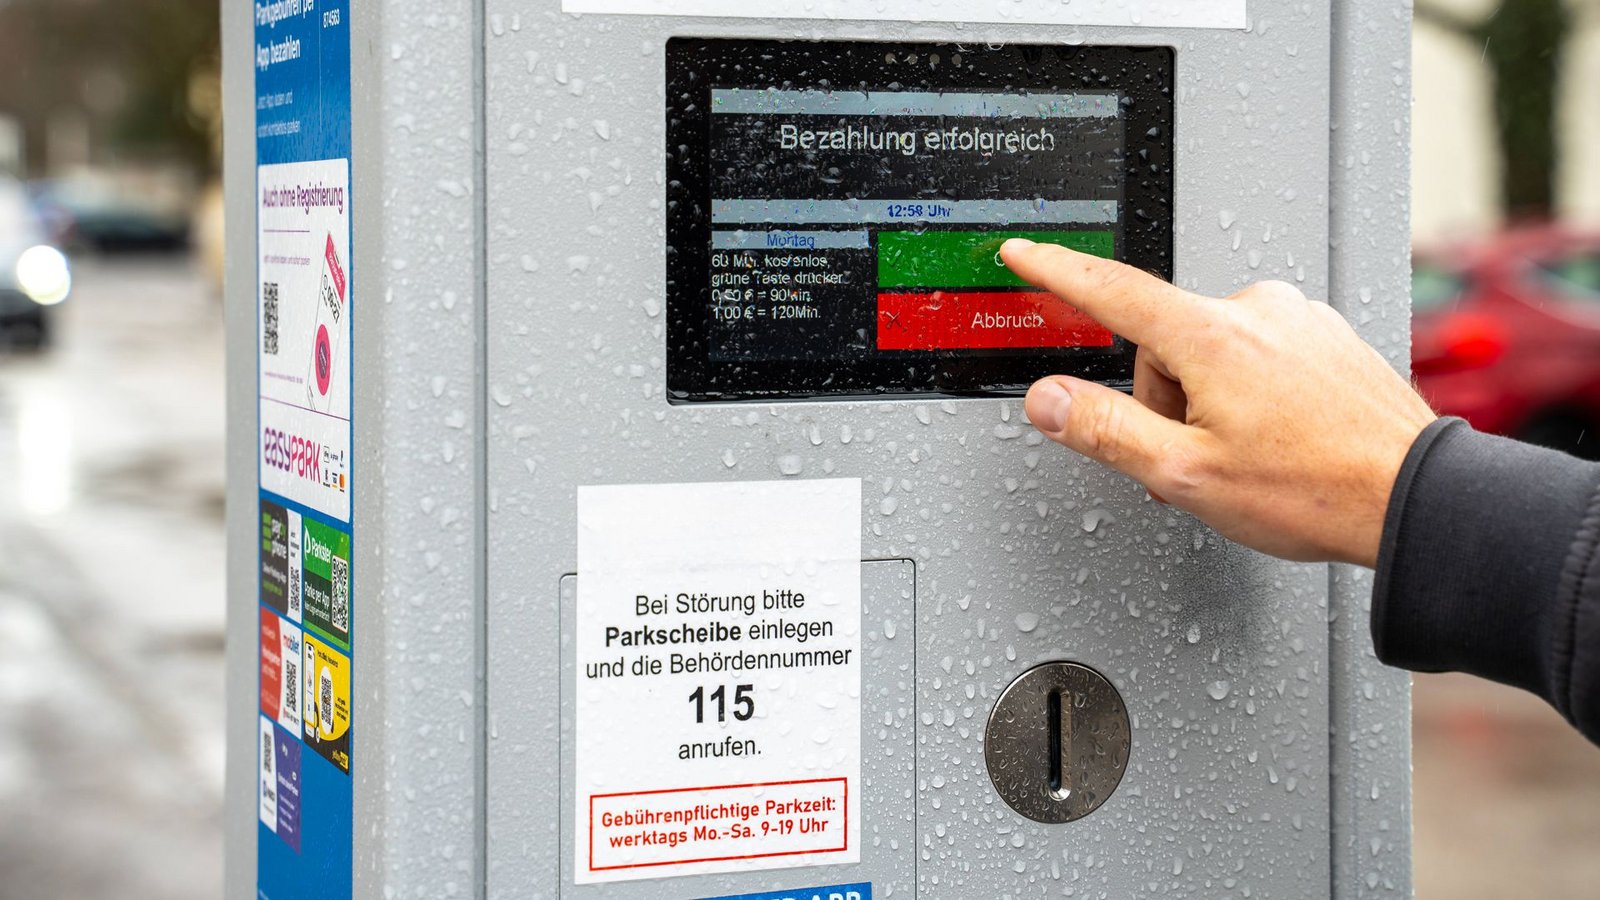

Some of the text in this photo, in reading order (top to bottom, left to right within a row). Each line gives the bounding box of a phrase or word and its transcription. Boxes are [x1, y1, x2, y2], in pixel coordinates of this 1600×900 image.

[257, 35, 300, 71] App bezahlen
[780, 124, 1055, 156] Bezahlung erfolgreich
[263, 181, 343, 215] Auch ohne Registrierung
[887, 204, 924, 218] 12:58
[766, 233, 815, 249] Montag
[711, 273, 750, 287] grüne
[752, 271, 791, 285] Taste
[971, 311, 1045, 329] Abbruch
[635, 588, 805, 617] Bei Störung bitte
[604, 617, 833, 648] Parkscheibe einlegen
[586, 645, 852, 679] und die Behördennummer
[688, 683, 755, 725] 115
[678, 735, 762, 760] anrufen.
[601, 795, 837, 829] Gebührenpflichtige Parkzeit:
[609, 817, 829, 848] werktags Mo.-Sa. 9-19 Uhr
